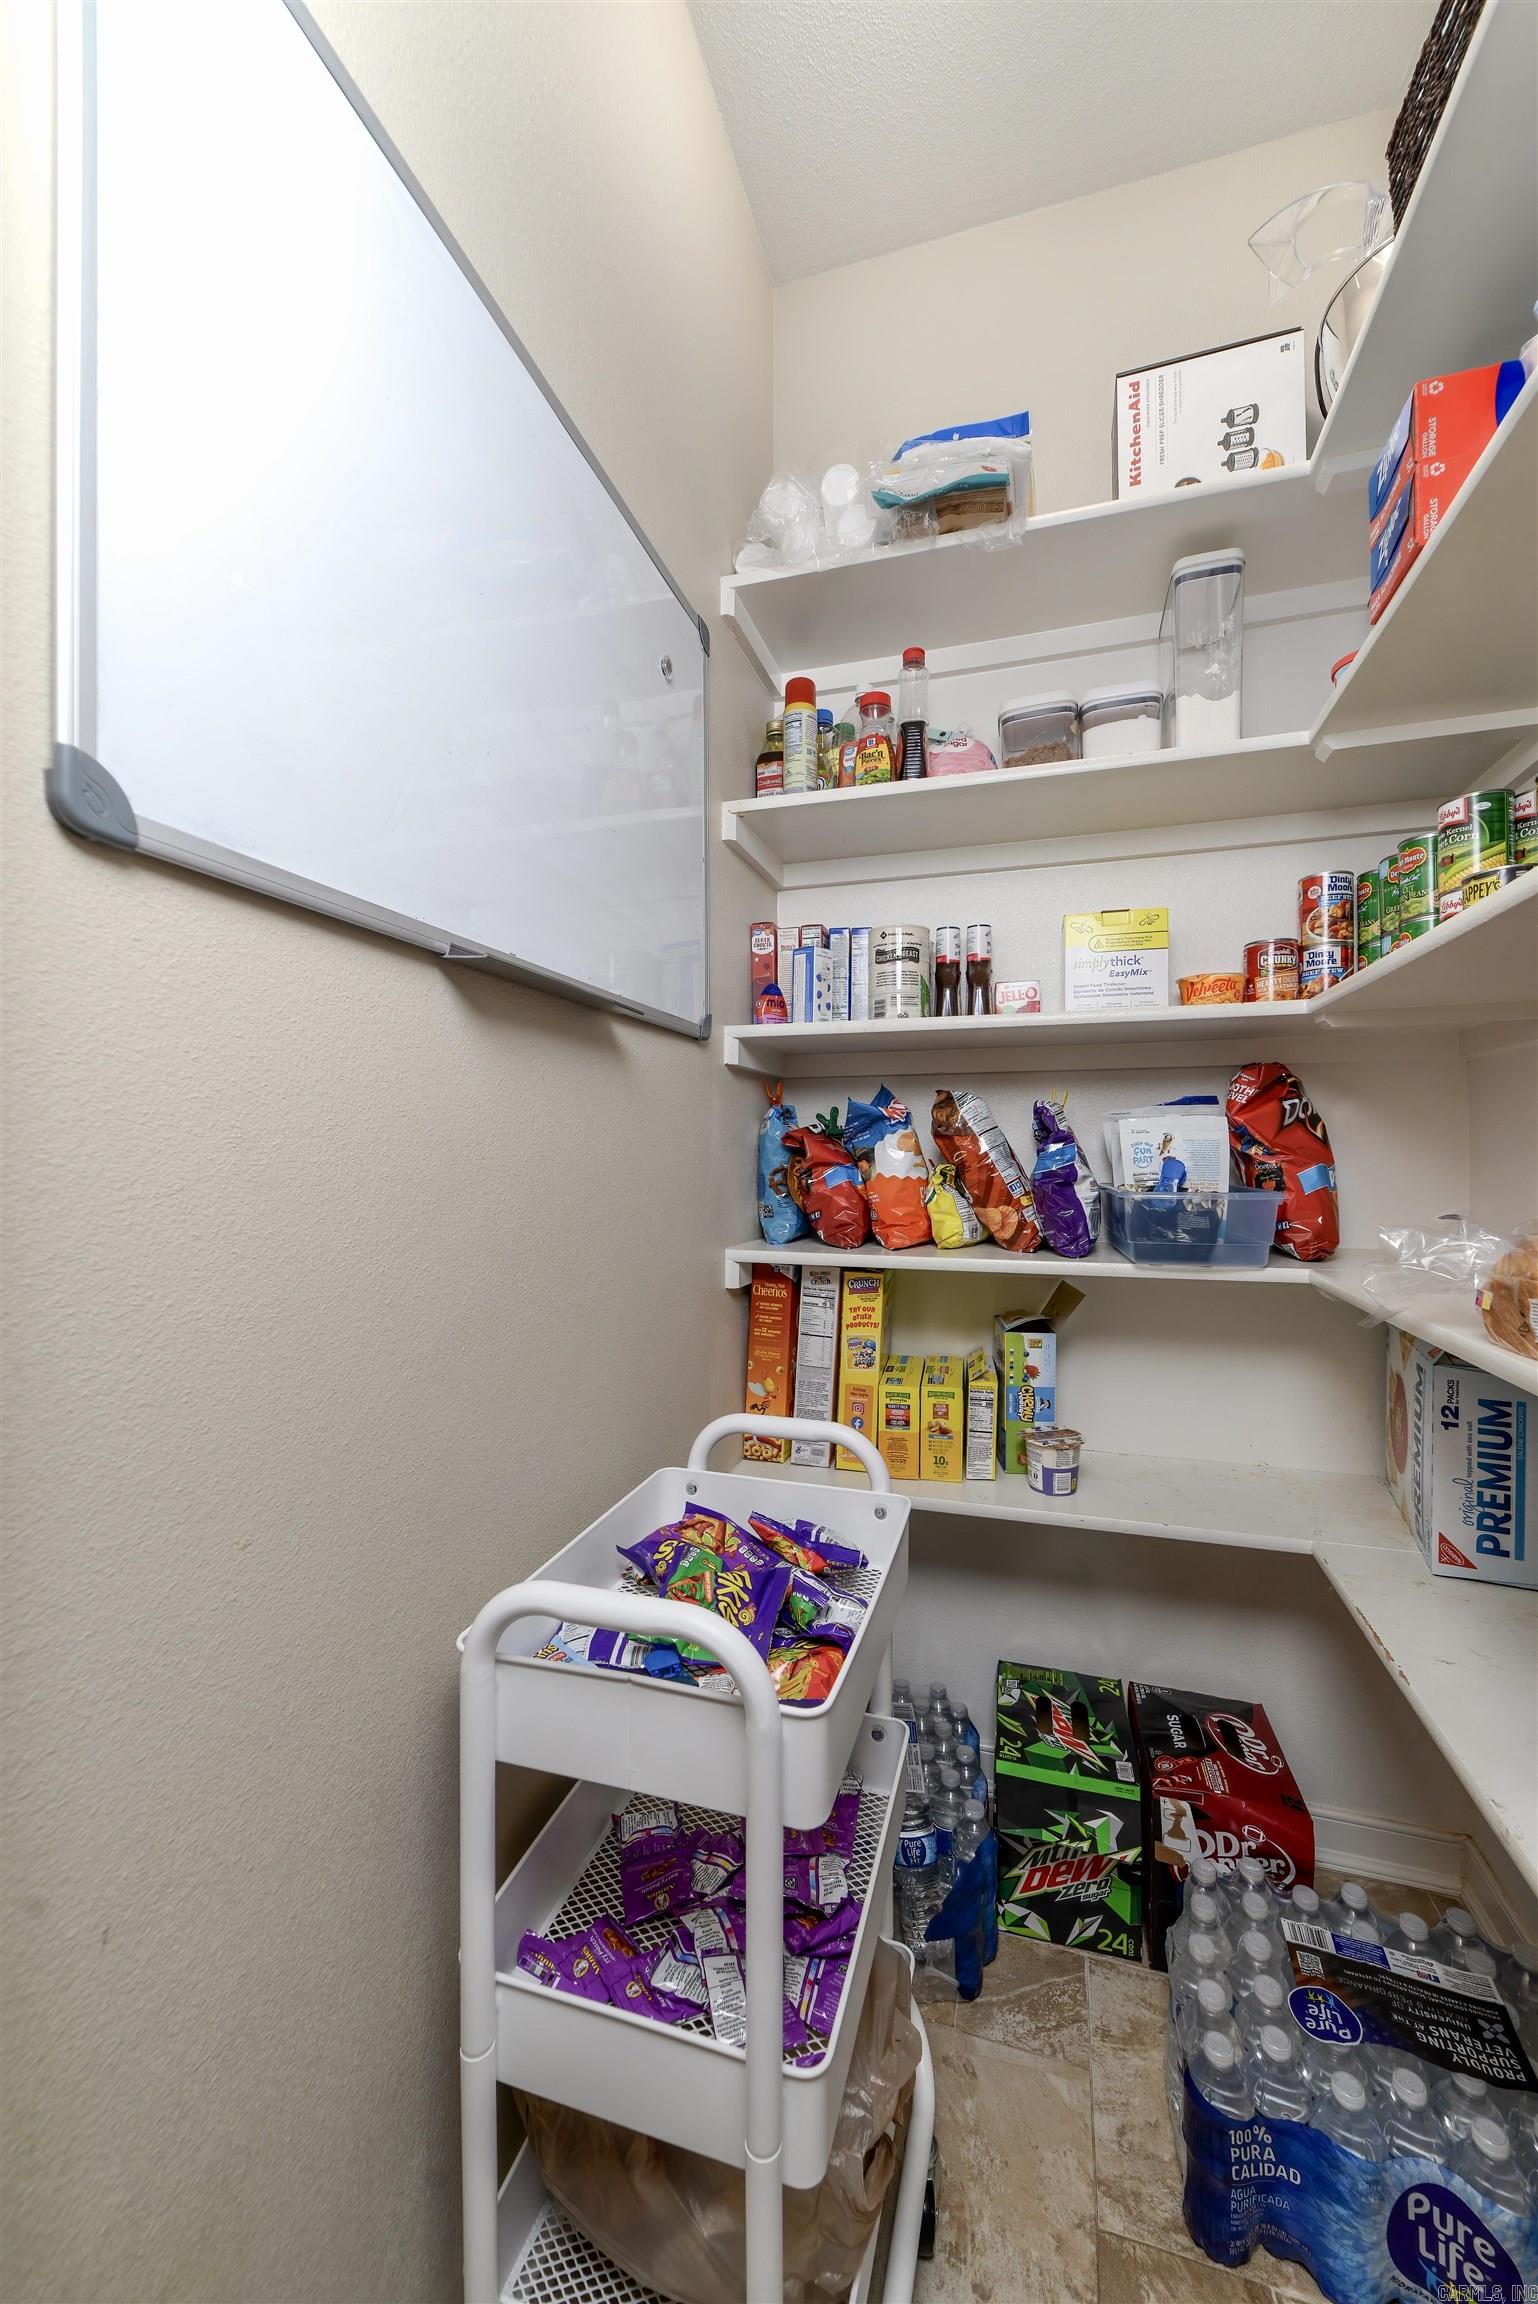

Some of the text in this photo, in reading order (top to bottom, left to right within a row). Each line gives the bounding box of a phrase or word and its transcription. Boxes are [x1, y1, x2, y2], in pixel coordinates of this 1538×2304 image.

[1129, 380, 1142, 487] KitchenAid
[1427, 416, 1437, 457] STORAGE
[1446, 824, 1473, 835] Kernel
[1449, 832, 1480, 844] Corn
[1328, 883, 1353, 892] Moore
[1329, 875, 1353, 885] Dinty
[1402, 885, 1414, 894] CUT
[1260, 954, 1297, 966] CHUNKY
[1110, 968, 1149, 978] EasyMix
[1186, 977, 1238, 1002] Velveeta
[752, 1284, 788, 1298] Cheerios
[848, 1279, 880, 1289] CRUNCH
[852, 1313, 872, 1321] OTHER
[1440, 1379, 1460, 1430] 12 PACKS
[1476, 1398, 1513, 1559] PREMIUM
[1451, 1477, 1482, 1527] original
[1100, 1678, 1121, 1697] 24
[1166, 1714, 1187, 1749] SUGAR
[904, 1838, 922, 1849] Pure
[906, 1845, 921, 1858] Life
[1082, 1889, 1111, 1902] sugar
[1098, 1929, 1128, 1956] 24
[1306, 2003, 1341, 2026] Life
[1407, 2006, 1472, 2031] UNIVERSITY
[1305, 2017, 1352, 2040] Pure
[1416, 2031, 1520, 2069] SUPPORTING
[1428, 2024, 1517, 2060] VETERANS
[1452, 2053, 1527, 2082] PROUDLY
[1228, 2124, 1273, 2145] 100%
[1231, 2144, 1276, 2163] PURA
[1231, 2162, 1301, 2185] CALIDAD
[1231, 2186, 1256, 2201] AGUA
[1231, 2194, 1290, 2213] PURIFICADA
[1407, 2192, 1496, 2269] Pure
[1418, 2226, 1485, 2293] Life
